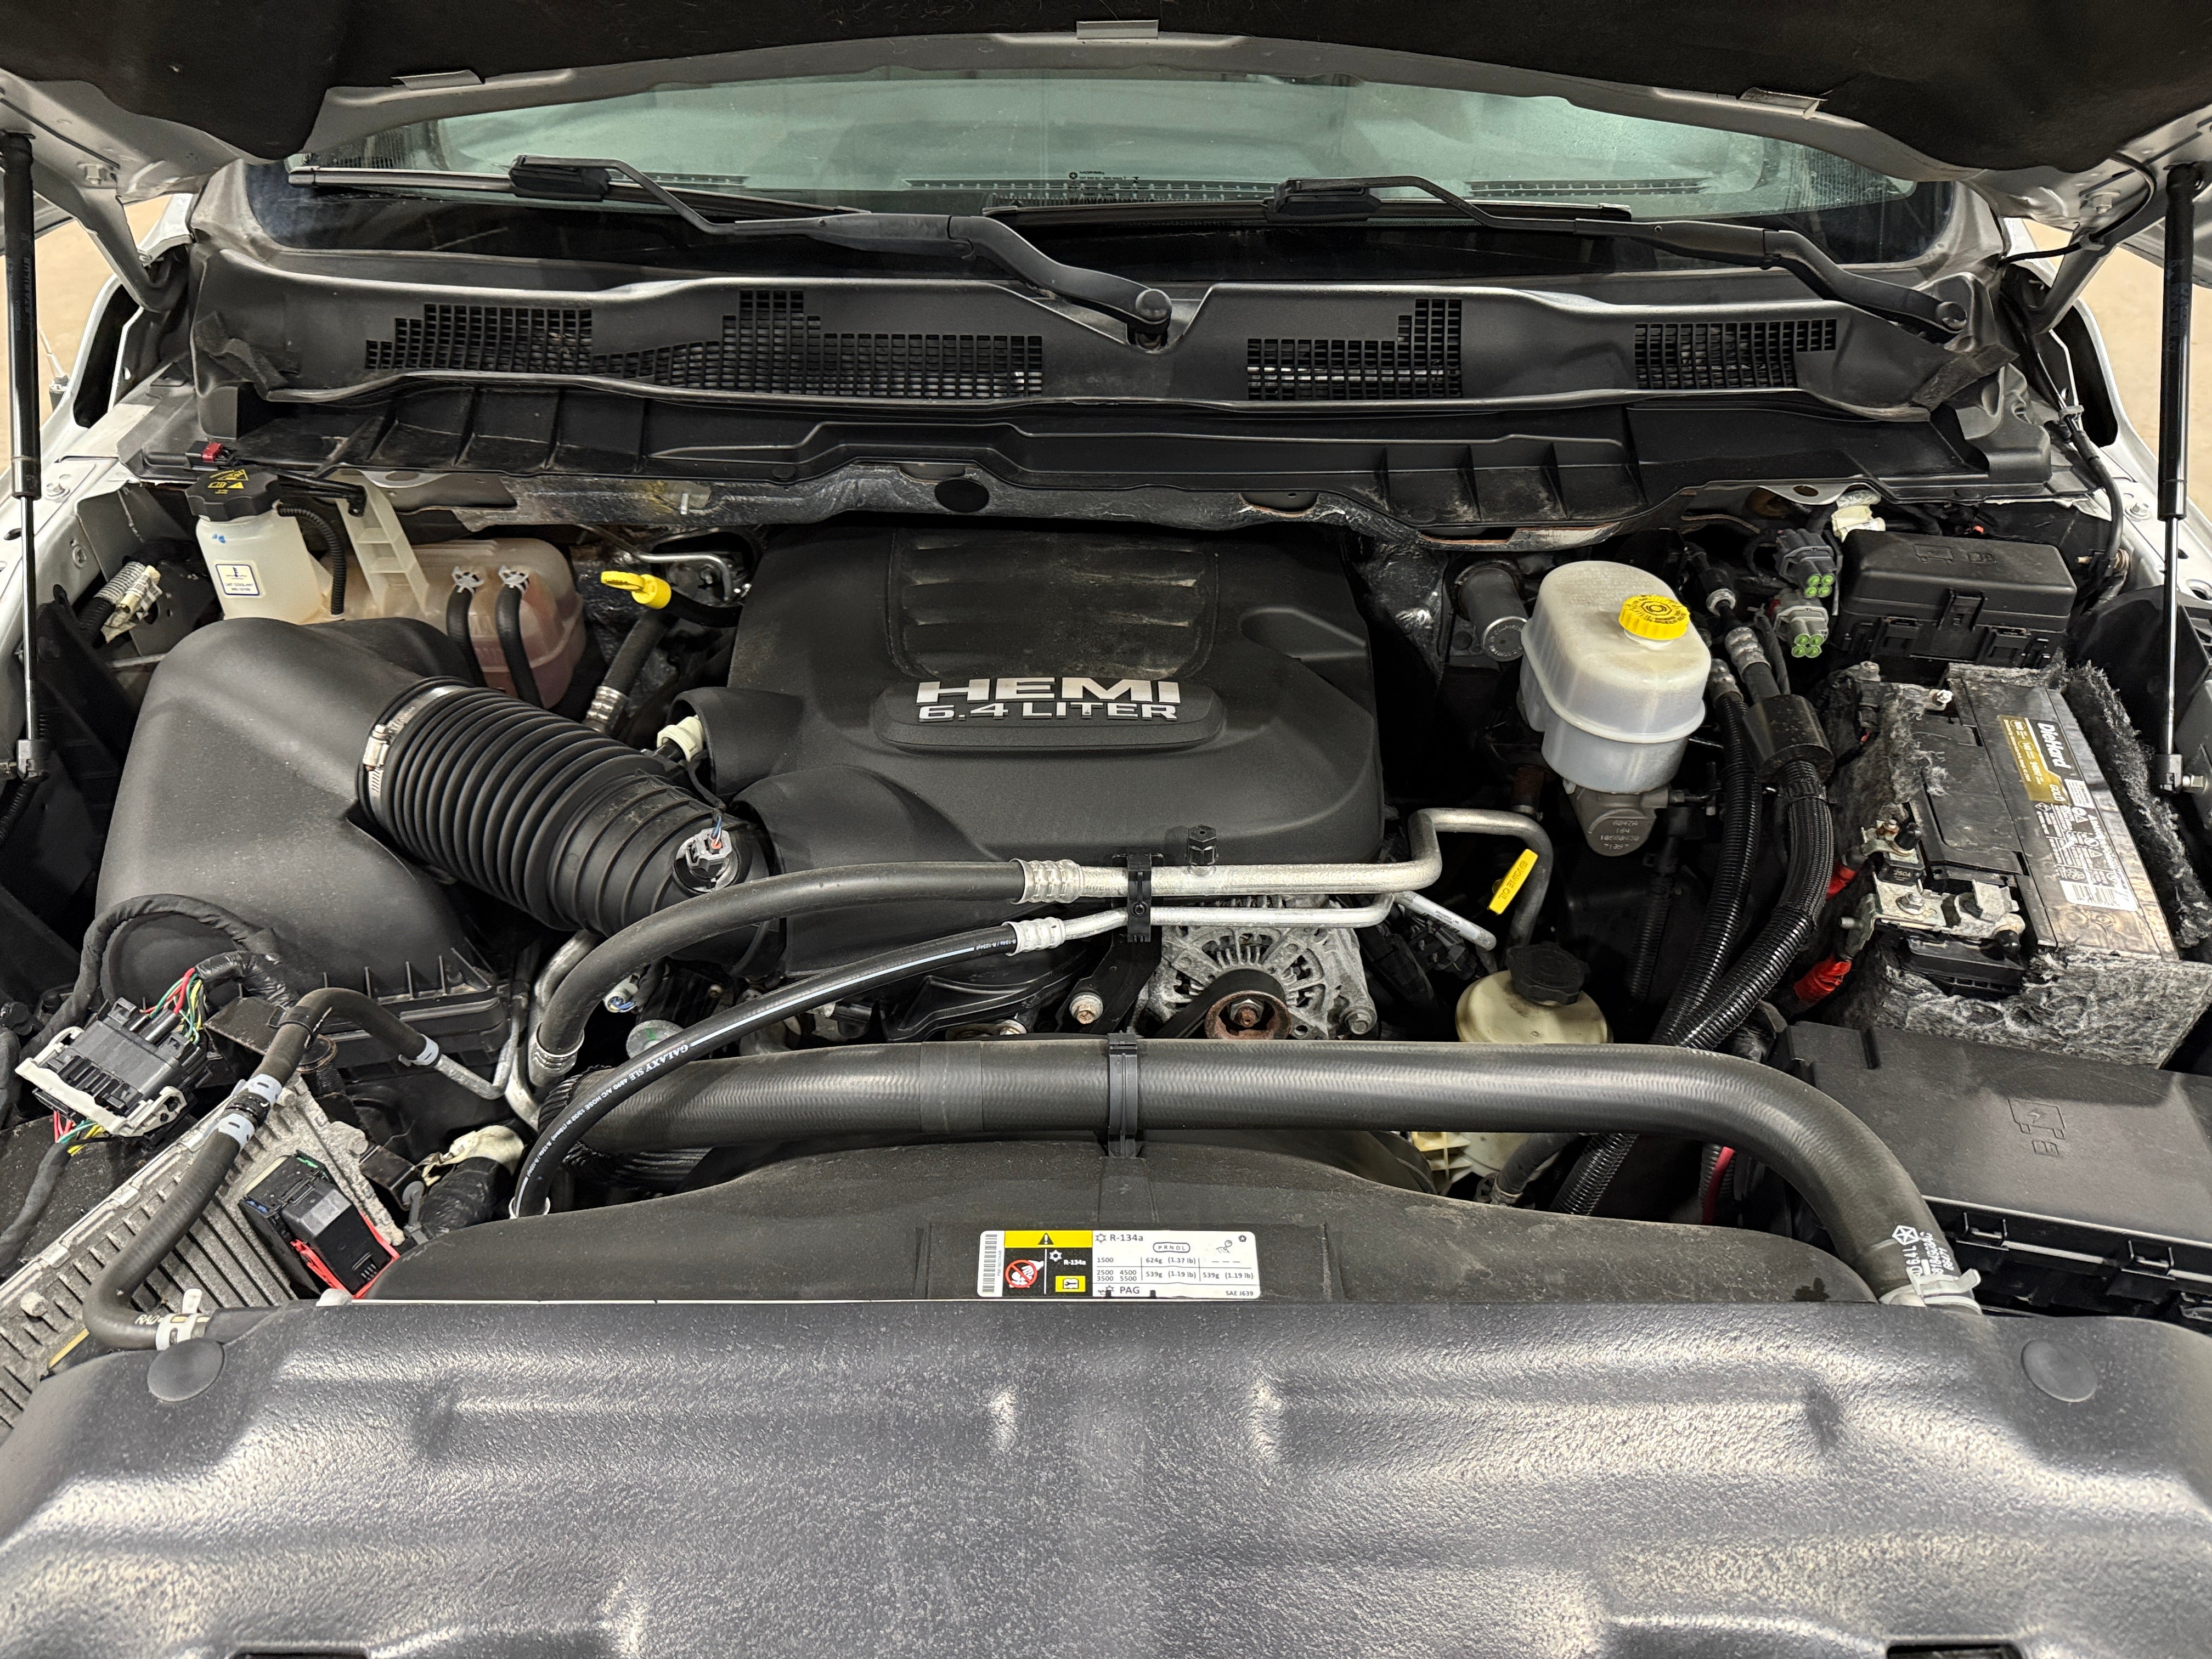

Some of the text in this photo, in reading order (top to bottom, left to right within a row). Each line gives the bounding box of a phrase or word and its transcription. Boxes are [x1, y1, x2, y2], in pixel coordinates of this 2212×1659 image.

[916, 676, 1181, 704] HEMI
[918, 702, 1177, 722] 6.4 LITER
[2038, 723, 2072, 769] DieHard
[2049, 784, 2066, 802] GOLD
[1498, 860, 1528, 900] ENGINE OIL
[646, 1044, 689, 1073] GALAXY
[628, 1068, 645, 1081] SLE
[601, 1087, 612, 1098] A/C
[584, 1096, 602, 1111] HOSE
[1902, 1245, 1921, 1265] 6.4L
[1120, 1286, 1140, 1294] PAG
